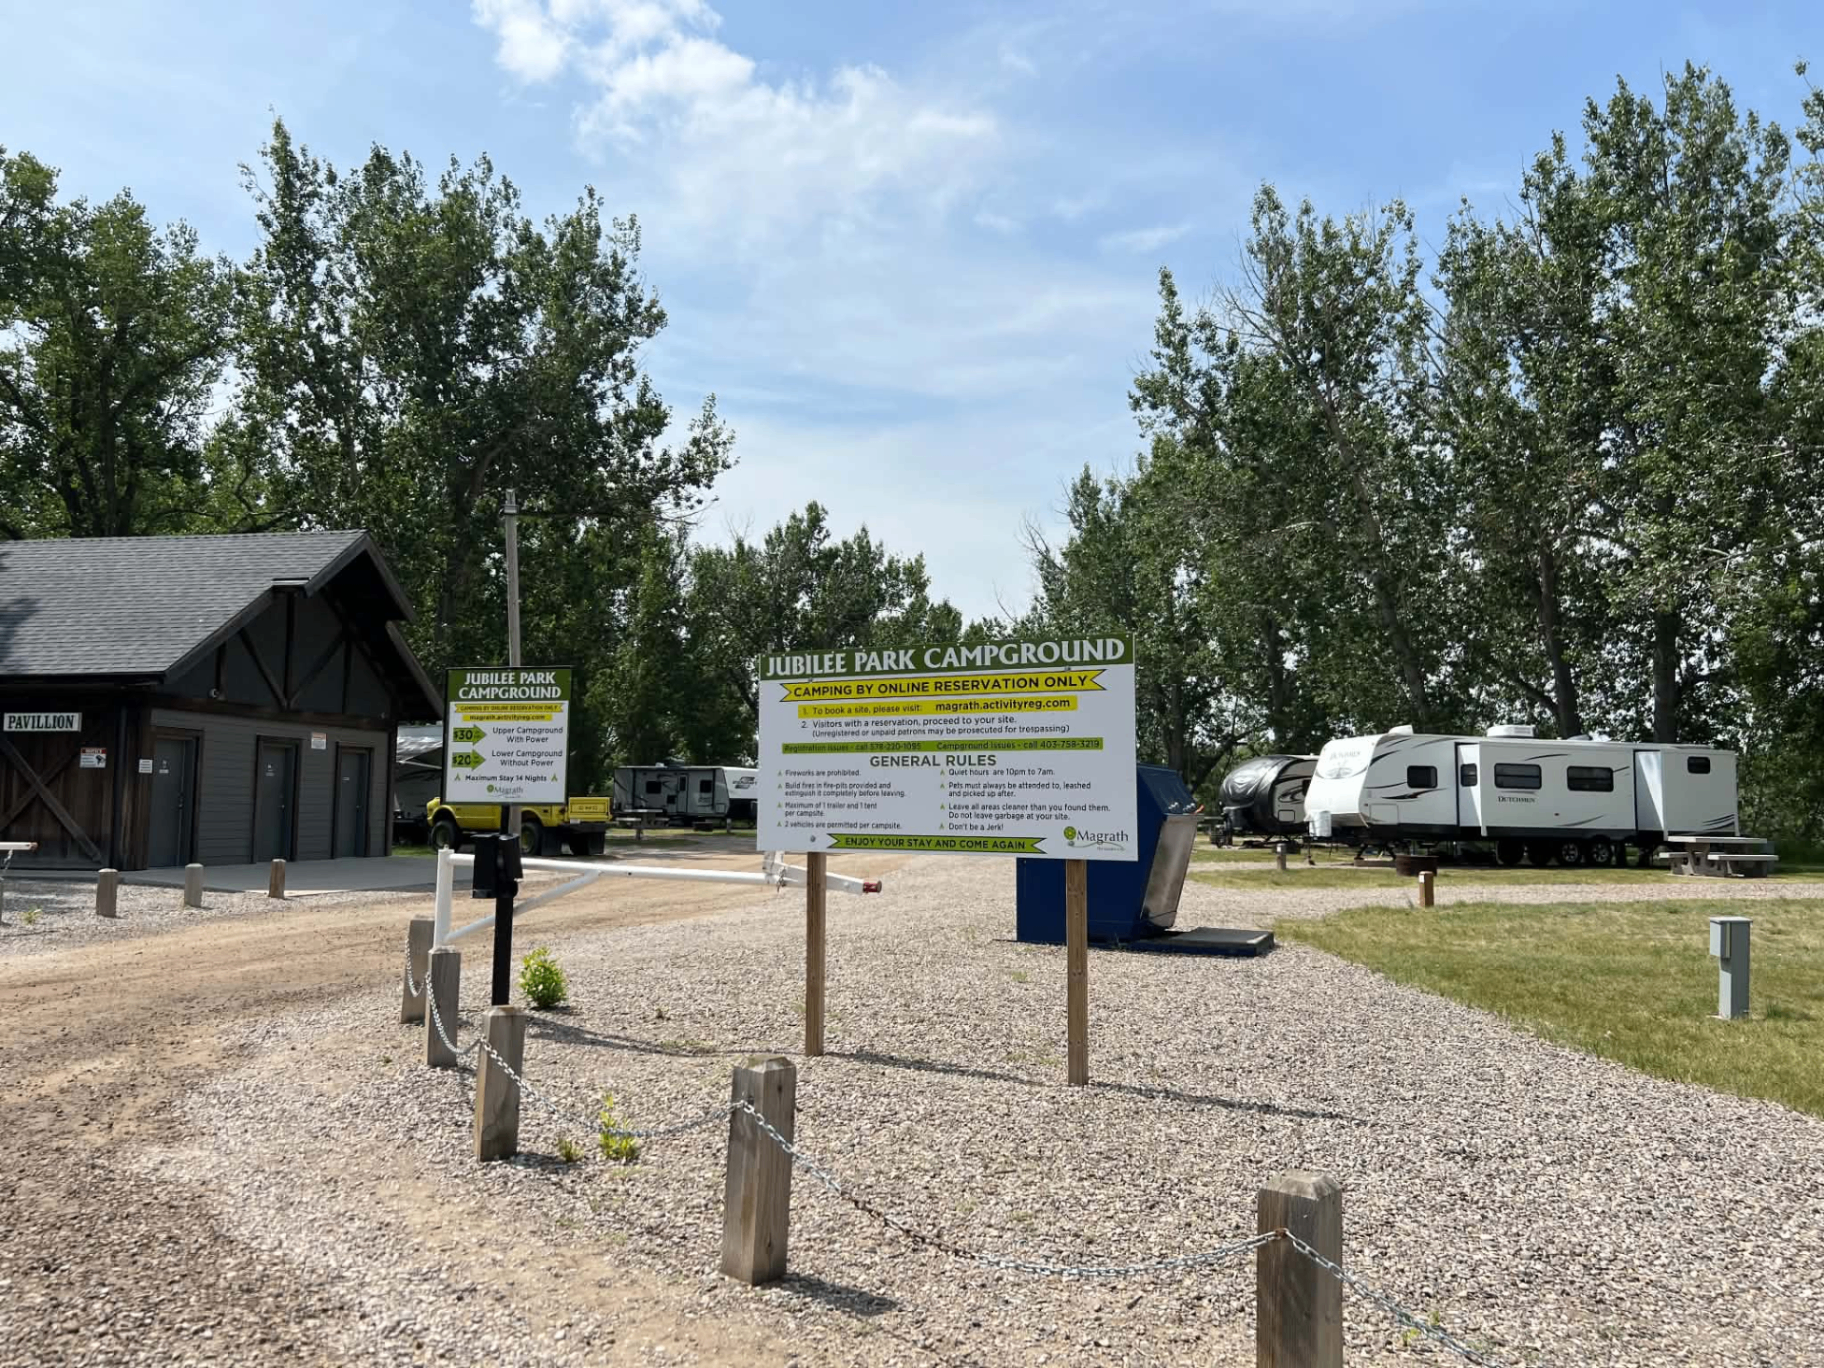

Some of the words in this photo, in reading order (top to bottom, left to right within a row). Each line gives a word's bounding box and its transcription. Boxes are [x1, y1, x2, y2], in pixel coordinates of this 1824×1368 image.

[766, 653, 846, 676] JUBILEE
[854, 649, 916, 672] PARK
[924, 638, 1125, 668] CAMPGROUND
[465, 672, 515, 685] JUBILEE
[520, 672, 556, 684] PARK
[458, 686, 562, 698] CAMPGROUND
[794, 684, 852, 698] CAMPING
[856, 684, 872, 695] BY
[878, 682, 929, 694] ONLINE
[934, 678, 1039, 692] RESERVATION
[1044, 676, 1088, 688] ONLY
[812, 706, 823, 714] To
[825, 706, 845, 714] book
[854, 706, 871, 714] site,
[873, 705, 900, 715] please
[902, 704, 922, 712] visit:
[936, 699, 1070, 712] magrath.activityreg.com
[8, 714, 74, 730] PAVILLION
[812, 720, 842, 728] Visitors
[844, 720, 862, 728] with
[872, 718, 921, 728] reservation,
[923, 716, 960, 727] proceed
[962, 716, 972, 724] to
[974, 717, 995, 726] your
[998, 716, 1016, 724] site.
[492, 726, 514, 736] Upper
[516, 726, 563, 736] Campground
[812, 729, 860, 738] (Unregistered
[871, 728, 896, 736] unpaid
[898, 728, 926, 737] patrons
[946, 726, 956, 734] be
[958, 726, 1003, 736] prosecuted
[1004, 725, 1017, 734] for
[1018, 724, 1070, 734] trespassing)
[936, 741, 988, 750] Campground
[990, 740, 1016, 749] issues
[1024, 740, 1038, 748] call
[516, 750, 562, 758] Campground
[870, 754, 941, 768] GENERAL
[946, 754, 996, 766] RULES
[827, 769, 861, 778] prohibited.
[1006, 768, 1026, 777] 10pm
[500, 774, 513, 782] Stay
[525, 774, 547, 782] Nights
[494, 786, 524, 795] Magrath
[823, 782, 848, 790] fire-pits
[849, 782, 877, 790] provided
[982, 782, 1006, 790] always
[1052, 782, 1062, 790] to,
[823, 790, 857, 798] completely
[1064, 804, 1086, 812] found
[995, 812, 1024, 820] garbage
[872, 822, 902, 830] campsite.
[1076, 830, 1128, 845] Magrath
[845, 837, 874, 846] ENJOY
[878, 838, 906, 846] YOUR
[907, 838, 932, 847] STAY
[936, 840, 956, 848] AND
[959, 840, 988, 848] COME
[992, 840, 1026, 850] AGAIN
